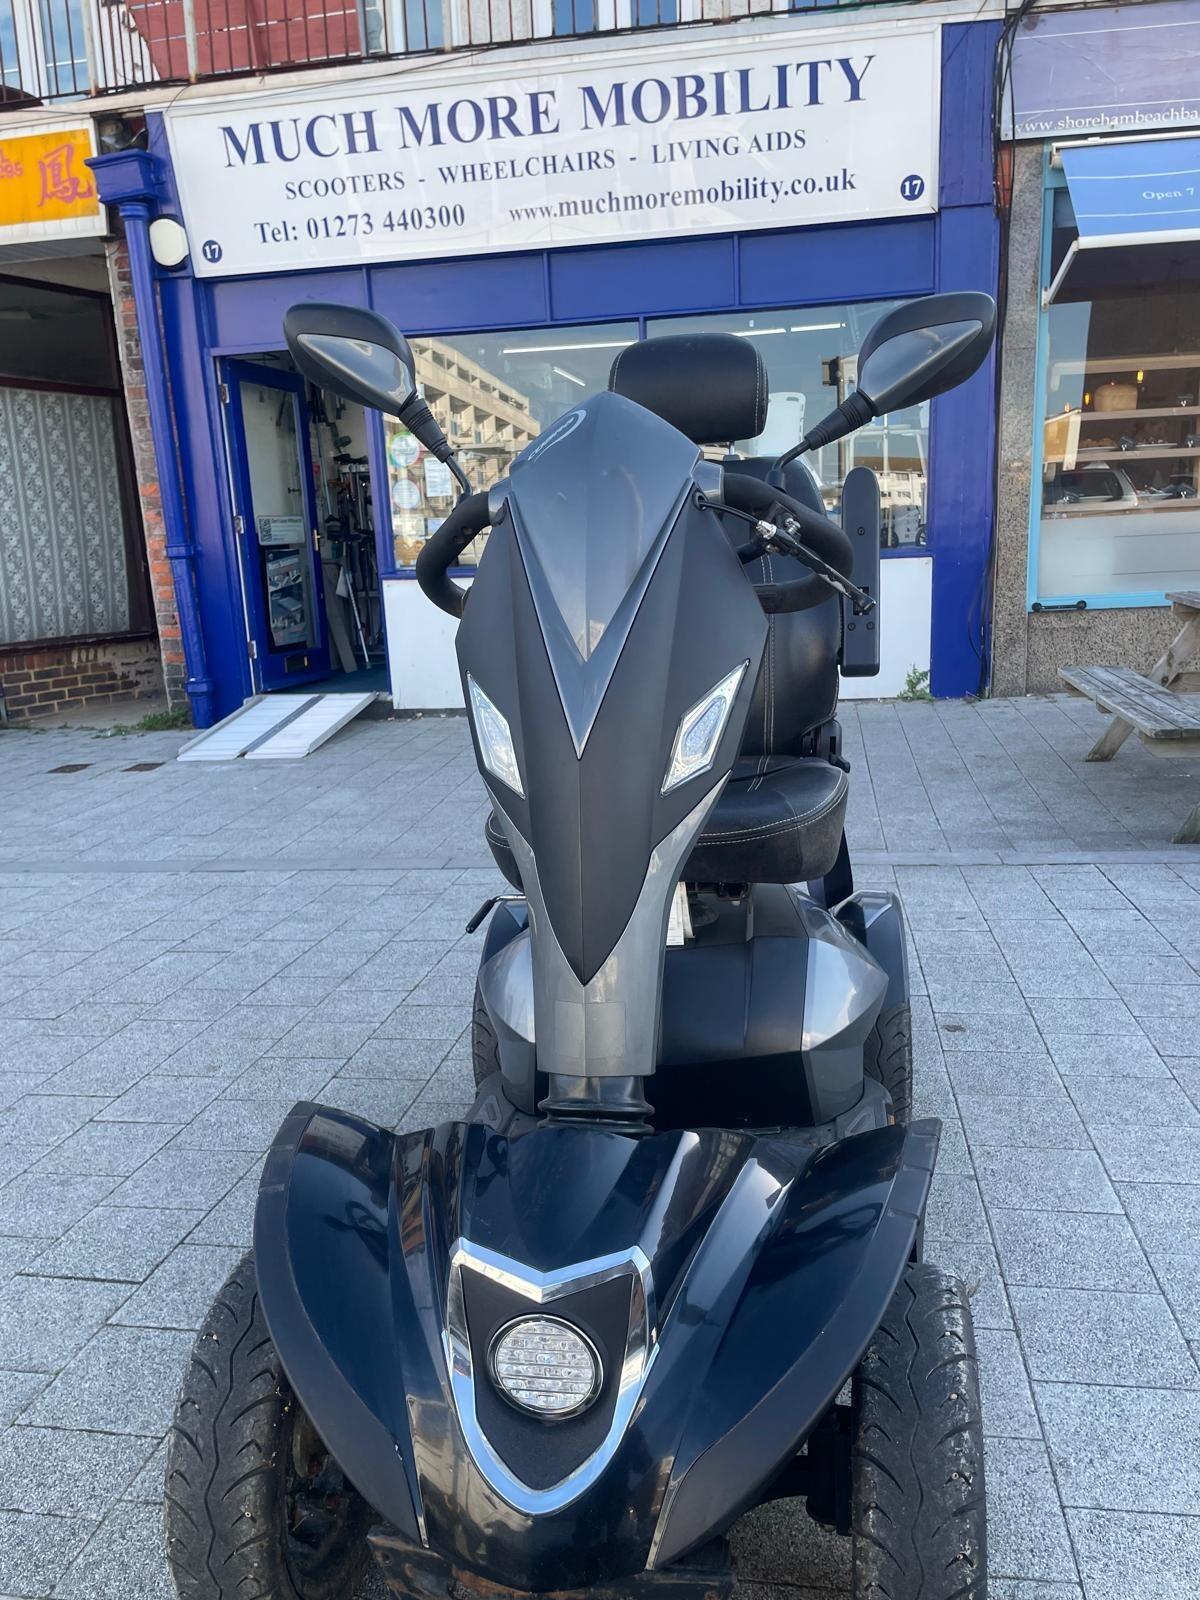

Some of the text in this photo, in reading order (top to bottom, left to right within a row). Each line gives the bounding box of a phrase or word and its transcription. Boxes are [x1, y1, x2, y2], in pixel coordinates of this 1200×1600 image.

[219, 54, 877, 168] MUCH MORE MOBILITY
[284, 173, 405, 200] SCOOTERS
[437, 148, 616, 185] WHEELCHAIRS
[652, 136, 740, 164] LIVING
[748, 128, 806, 154] AIDS
[509, 167, 857, 221] www.muchmoremobility.co.uk
[902, 178, 921, 197] 17
[1142, 190, 1182, 200] Open
[253, 203, 465, 244] Tel: 01273 440300
[205, 244, 220, 260] 17
